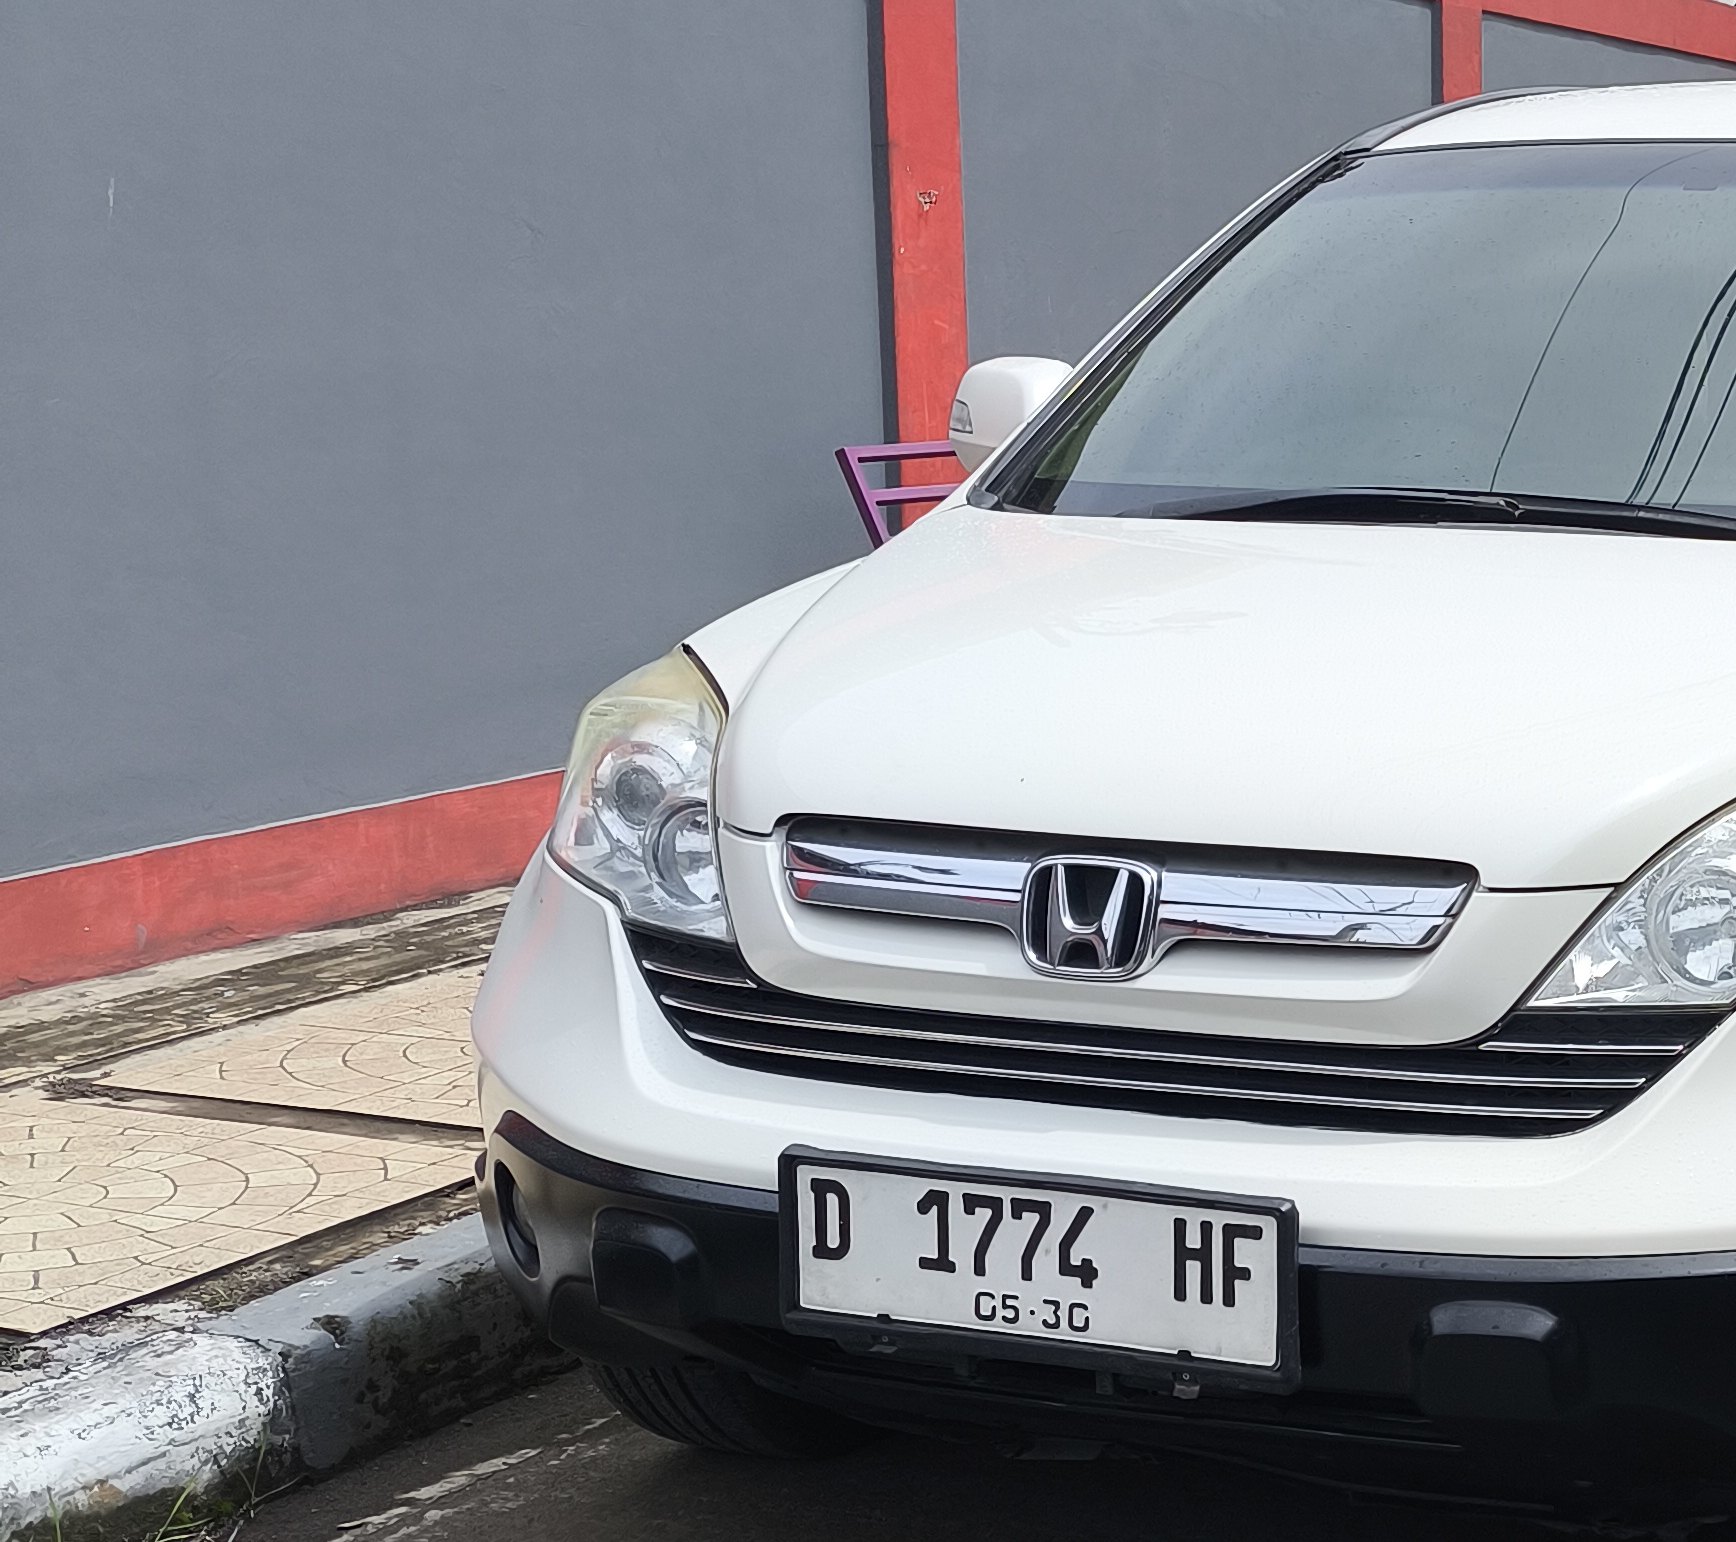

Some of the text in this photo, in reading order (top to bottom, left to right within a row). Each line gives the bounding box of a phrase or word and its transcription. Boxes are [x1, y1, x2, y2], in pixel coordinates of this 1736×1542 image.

[811, 1177, 1263, 1308] D 1774 HF
